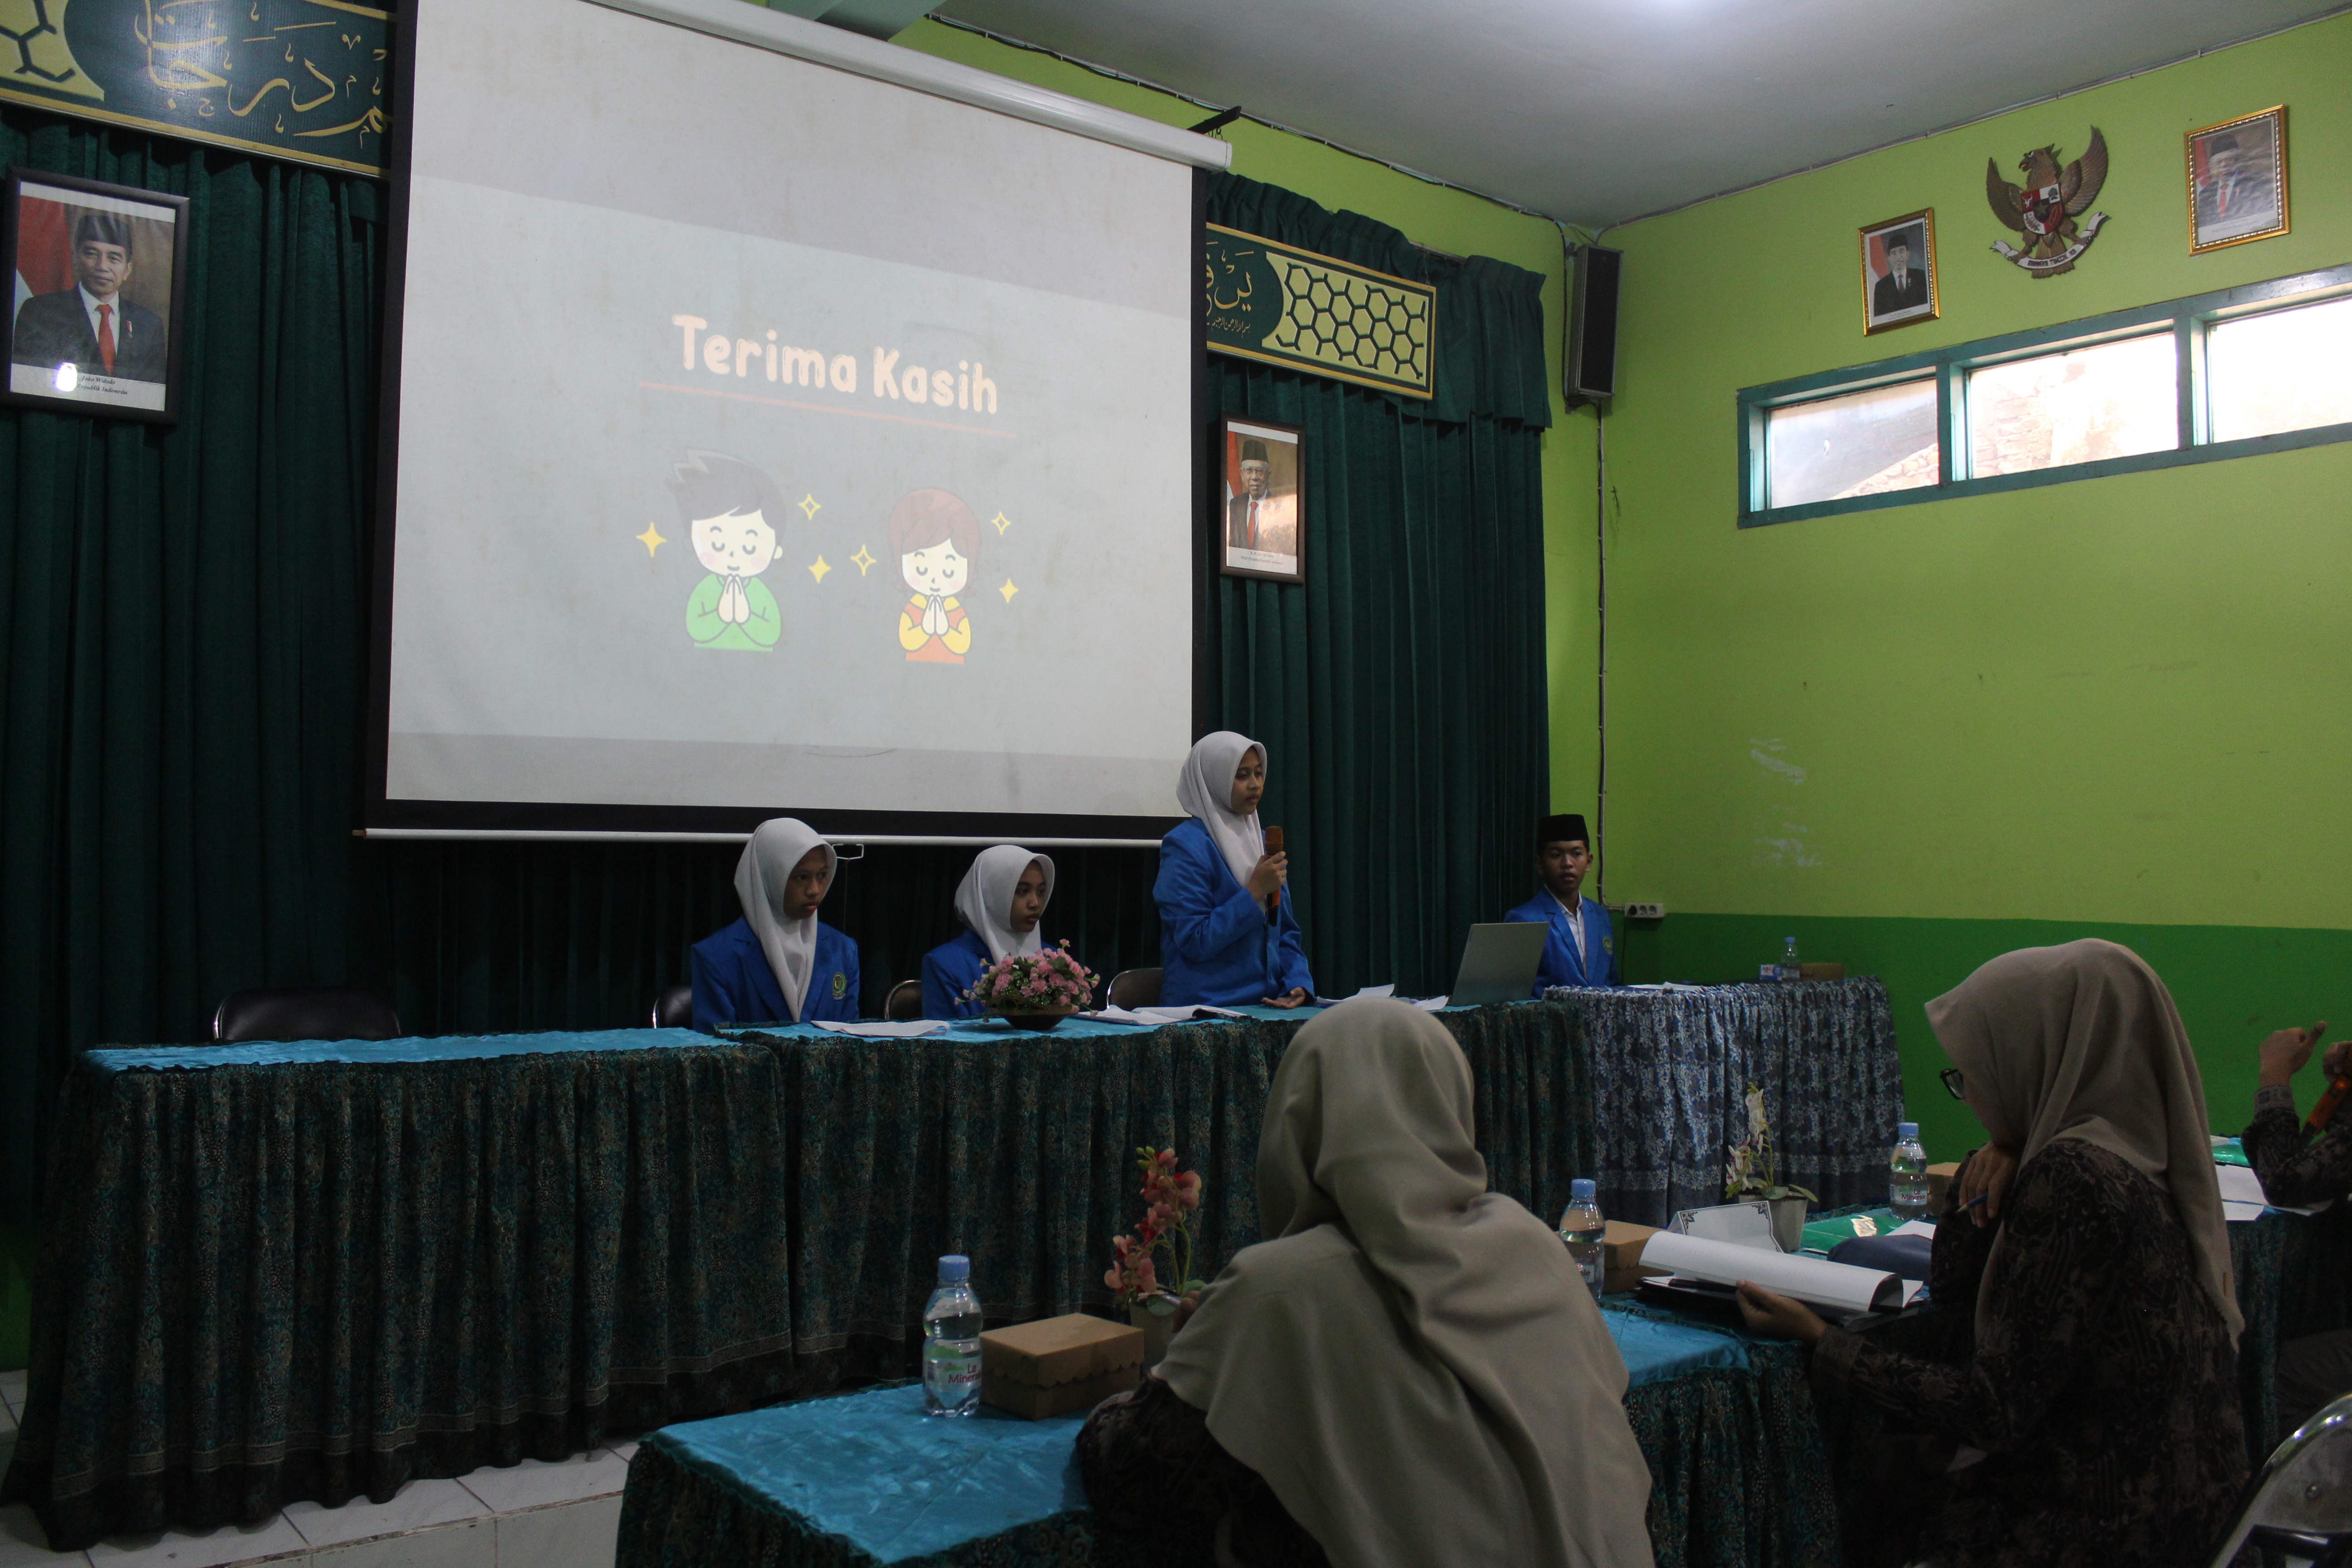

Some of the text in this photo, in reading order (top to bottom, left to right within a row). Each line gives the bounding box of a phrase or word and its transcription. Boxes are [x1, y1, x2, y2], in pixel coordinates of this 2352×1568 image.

[671, 314, 997, 414] Terima Kasih
[102, 387, 128, 395] Indonesia
[967, 1363, 977, 1374] Le
